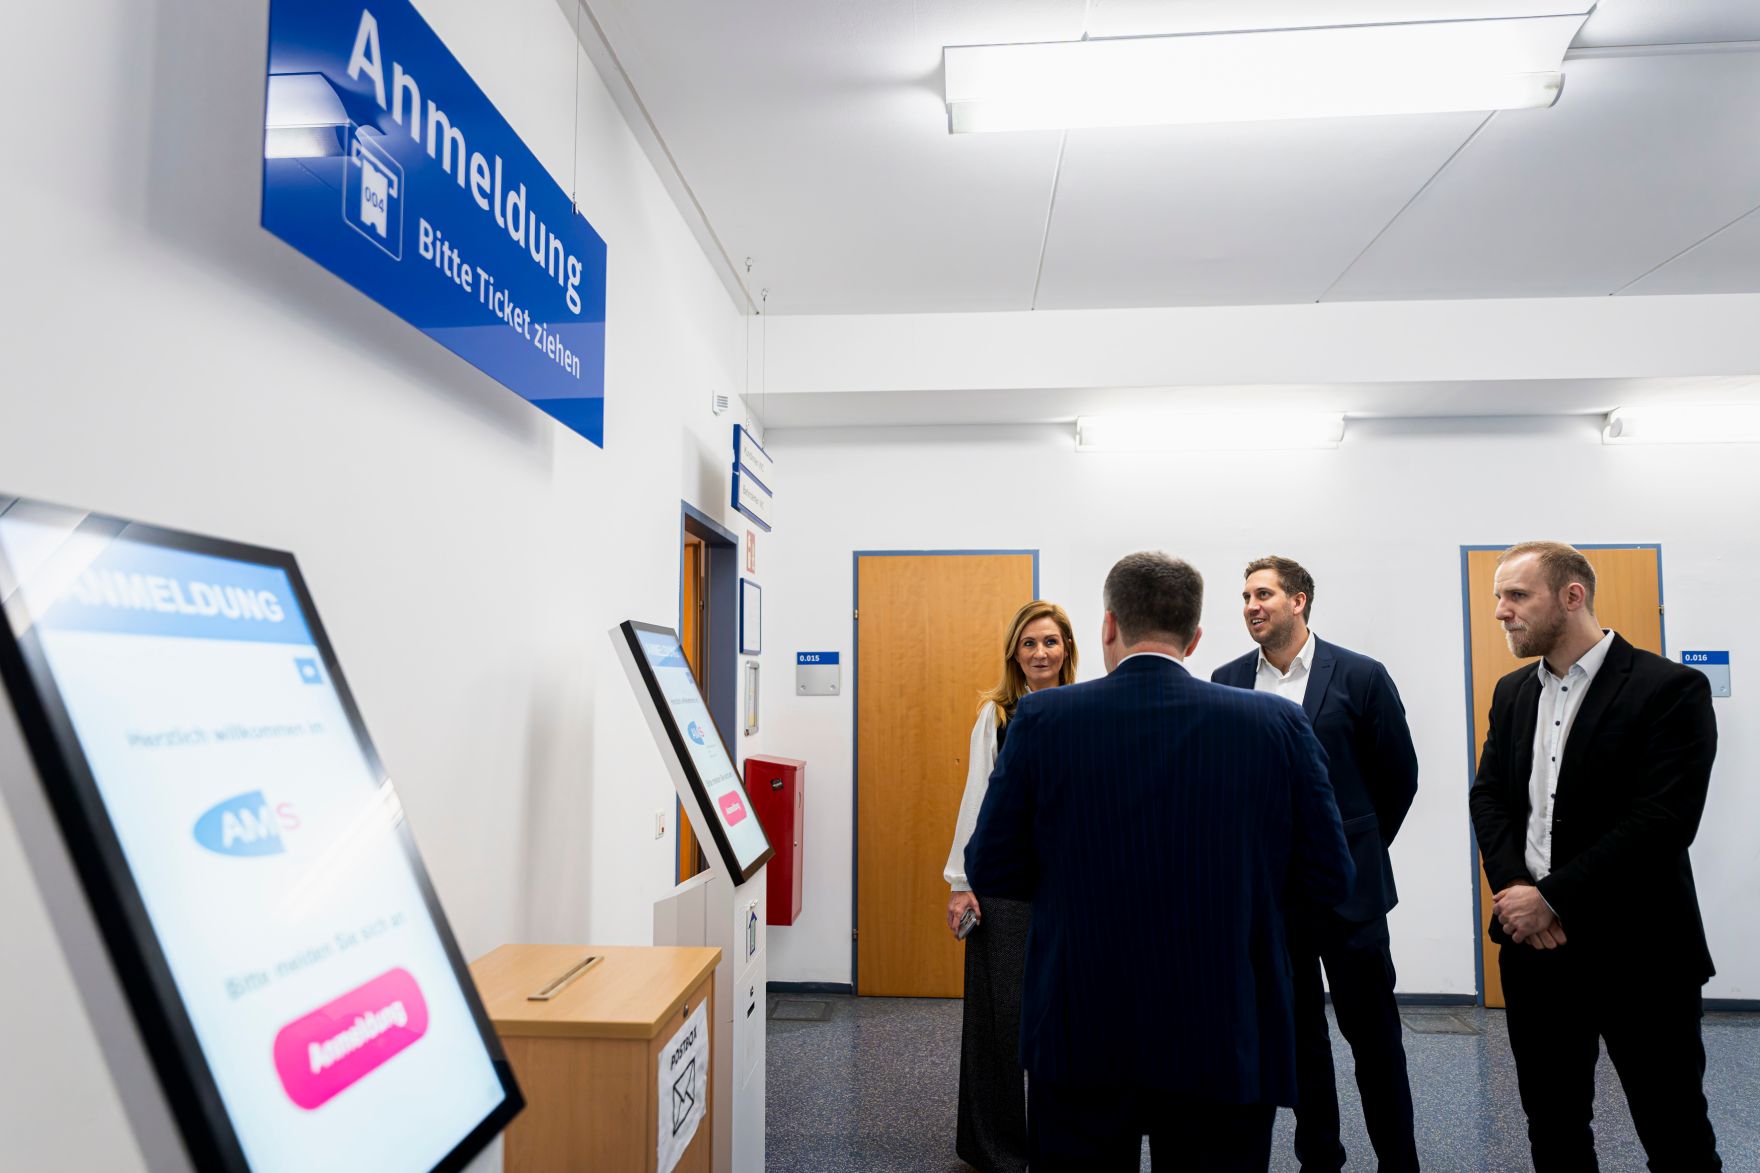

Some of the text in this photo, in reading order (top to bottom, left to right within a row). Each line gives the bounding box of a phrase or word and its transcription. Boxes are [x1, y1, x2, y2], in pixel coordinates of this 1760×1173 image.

[347, 8, 583, 315] Anmeldung
[365, 186, 385, 213] 004
[418, 217, 580, 379] Bitte Ticket ziehen
[799, 654, 820, 662] 0.015
[1685, 654, 1708, 662] 0.016
[220, 802, 301, 848] AMS
[671, 1026, 697, 1071] POSTBOX
